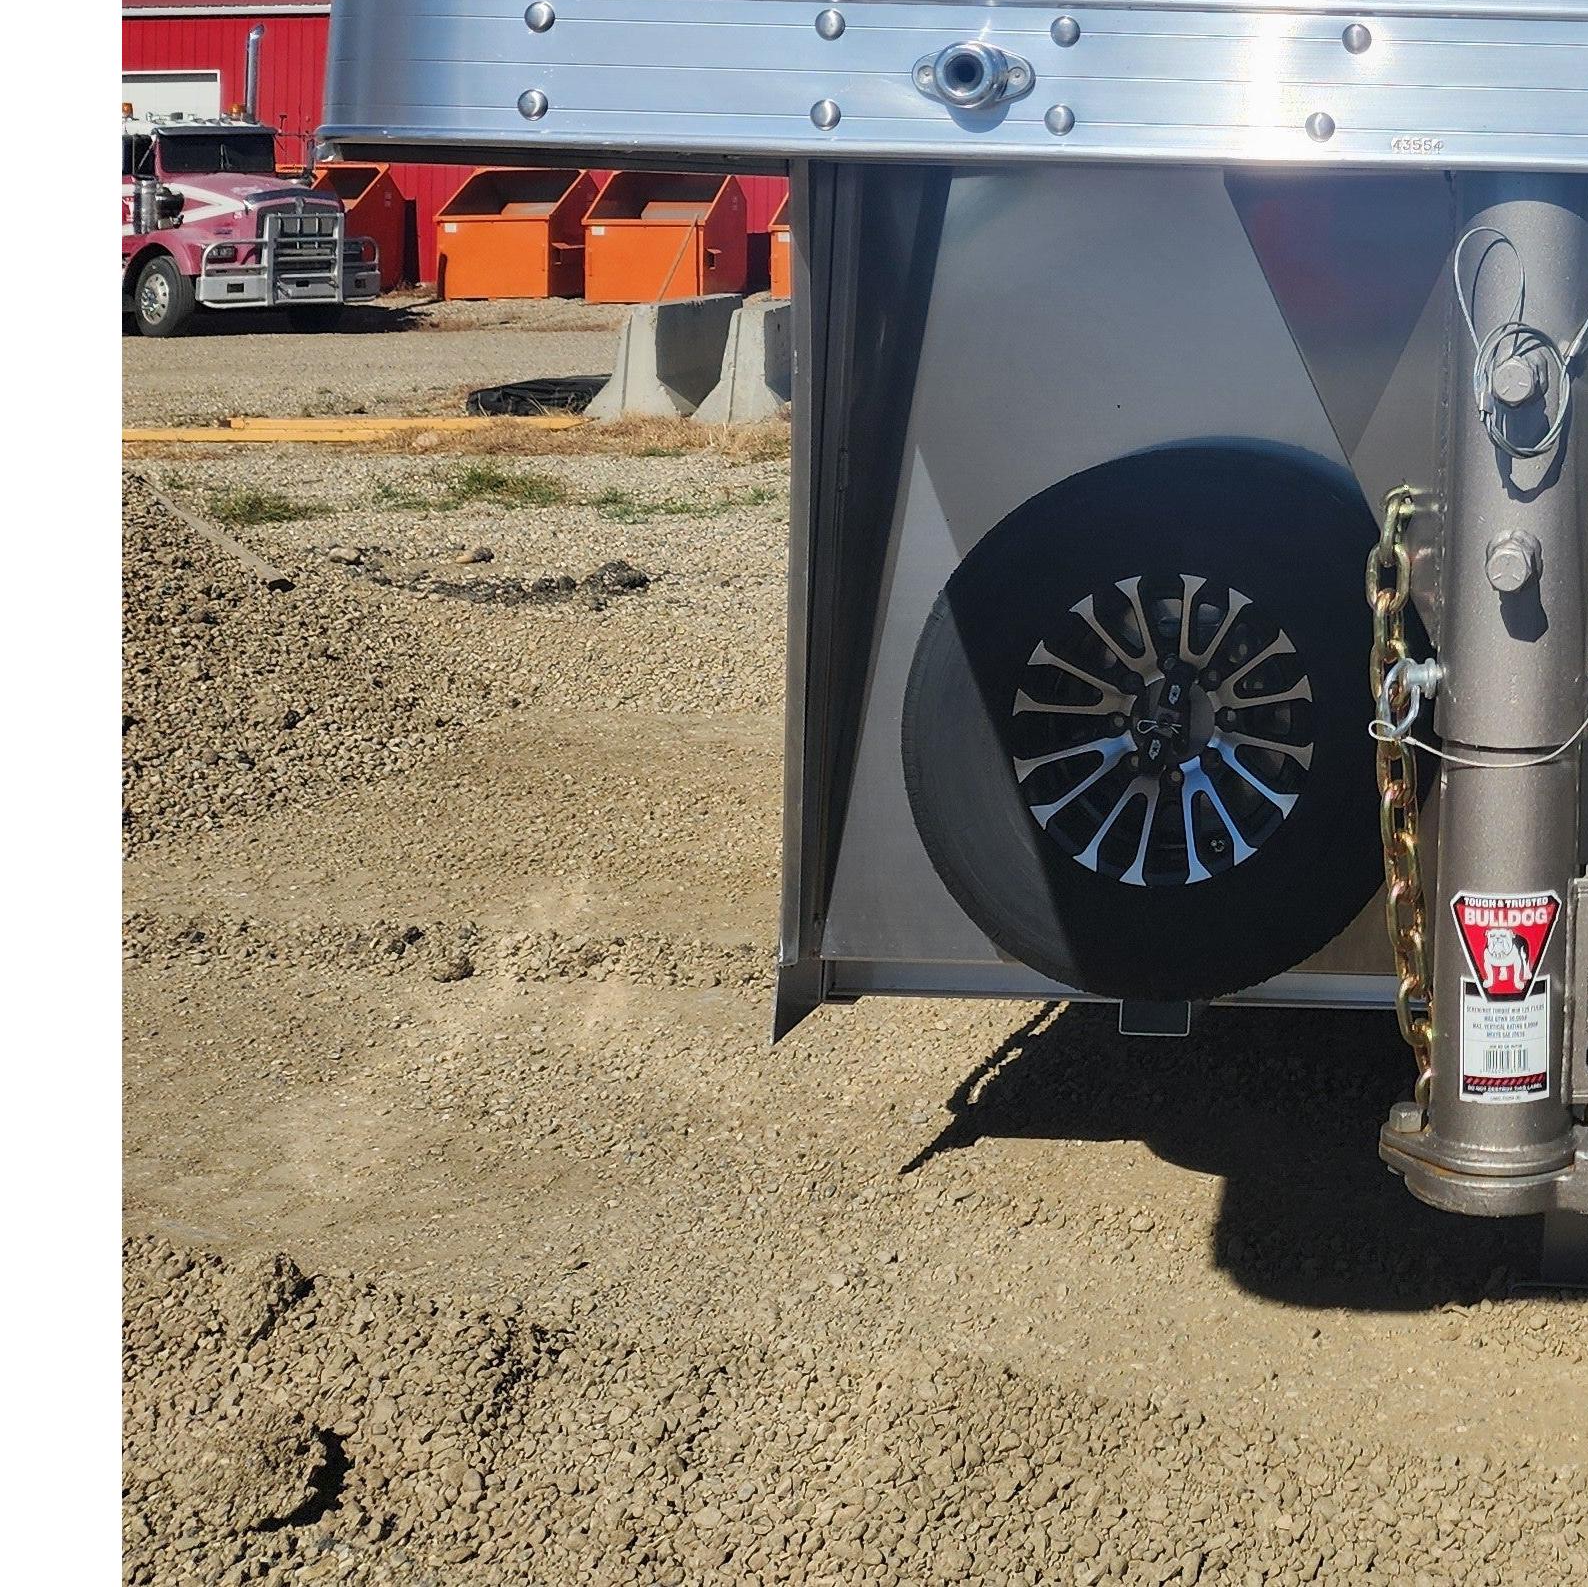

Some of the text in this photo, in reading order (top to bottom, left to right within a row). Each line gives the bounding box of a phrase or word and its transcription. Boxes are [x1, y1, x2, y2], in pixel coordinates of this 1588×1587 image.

[1464, 897, 1496, 908] TOUGH
[1505, 896, 1549, 909] TRUSTED
[1464, 907, 1548, 928] BULLDOG
